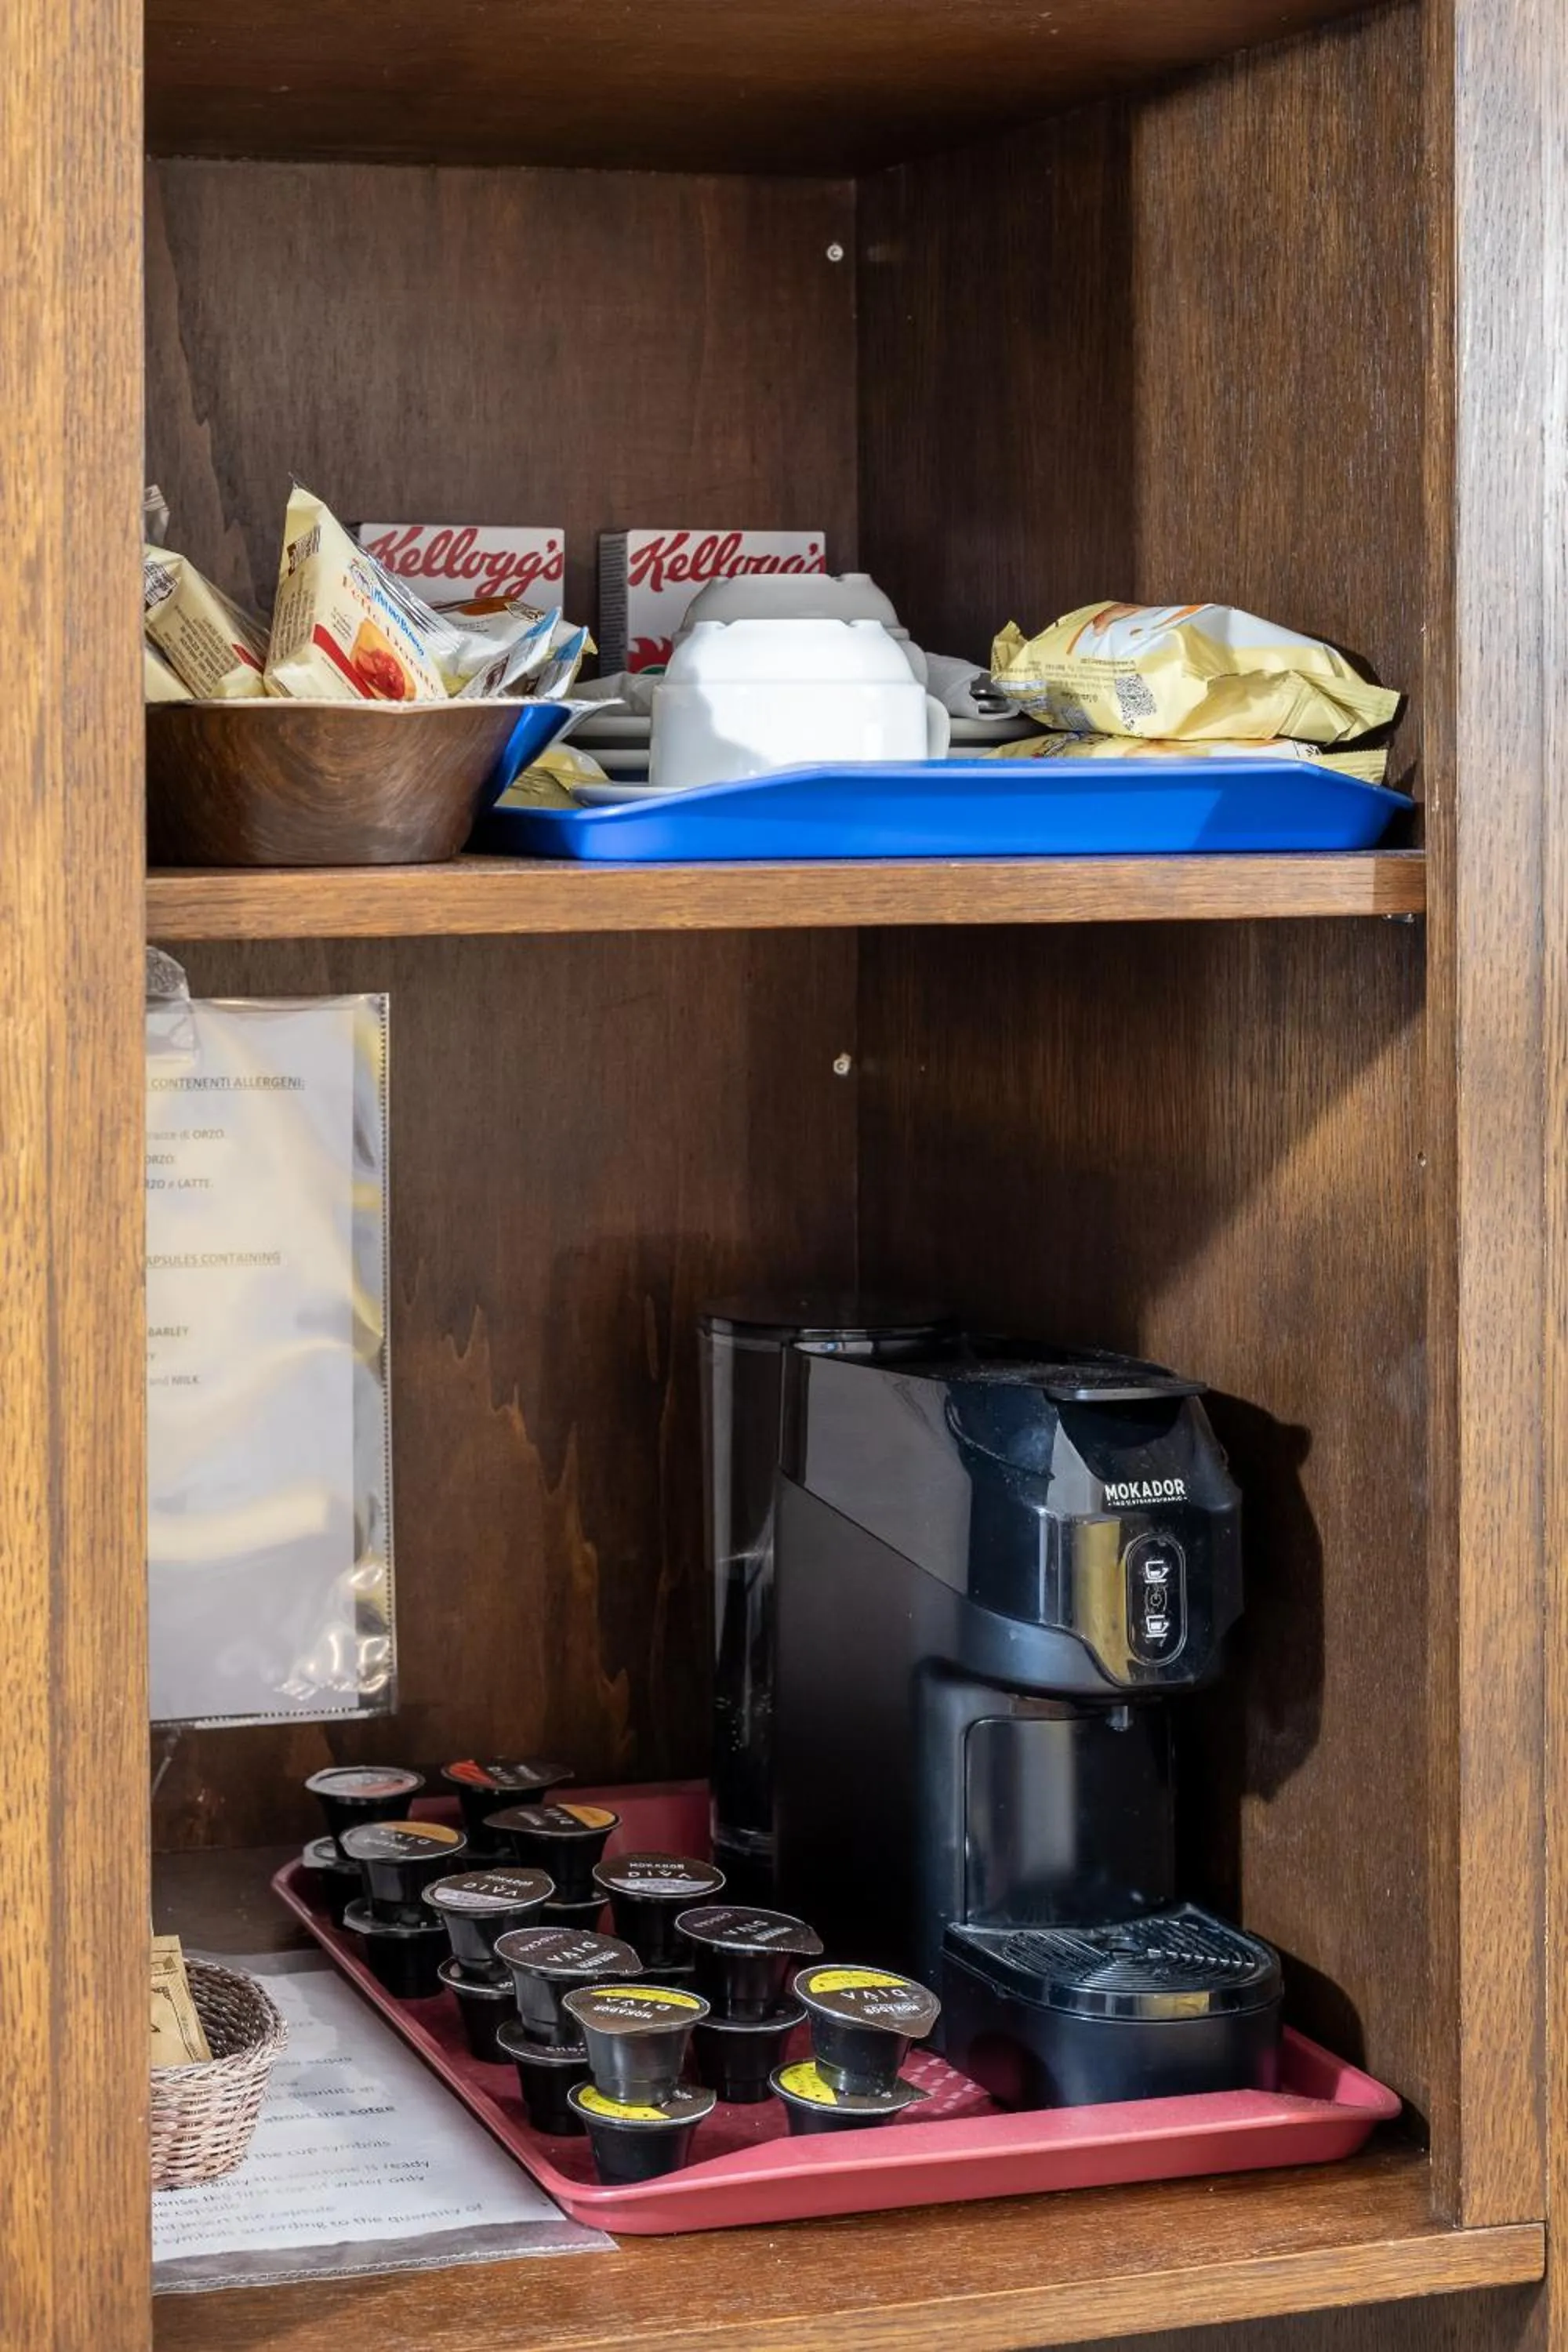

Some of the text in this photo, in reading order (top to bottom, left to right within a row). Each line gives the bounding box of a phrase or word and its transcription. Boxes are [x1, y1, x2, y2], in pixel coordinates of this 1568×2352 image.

[366, 526, 564, 599] Kellogg's
[151, 1077, 230, 1089] CONTENENTI
[1104, 1478, 1185, 1501] MOKADOR
[627, 1868, 692, 1879] DIVA
[462, 1882, 518, 1896] DIVA
[546, 1940, 598, 1962] DIVA
[839, 1987, 909, 2002] DIVA
[353, 2215, 383, 2226] the
[388, 2205, 460, 2223] quantity
[464, 2201, 484, 2212] of
